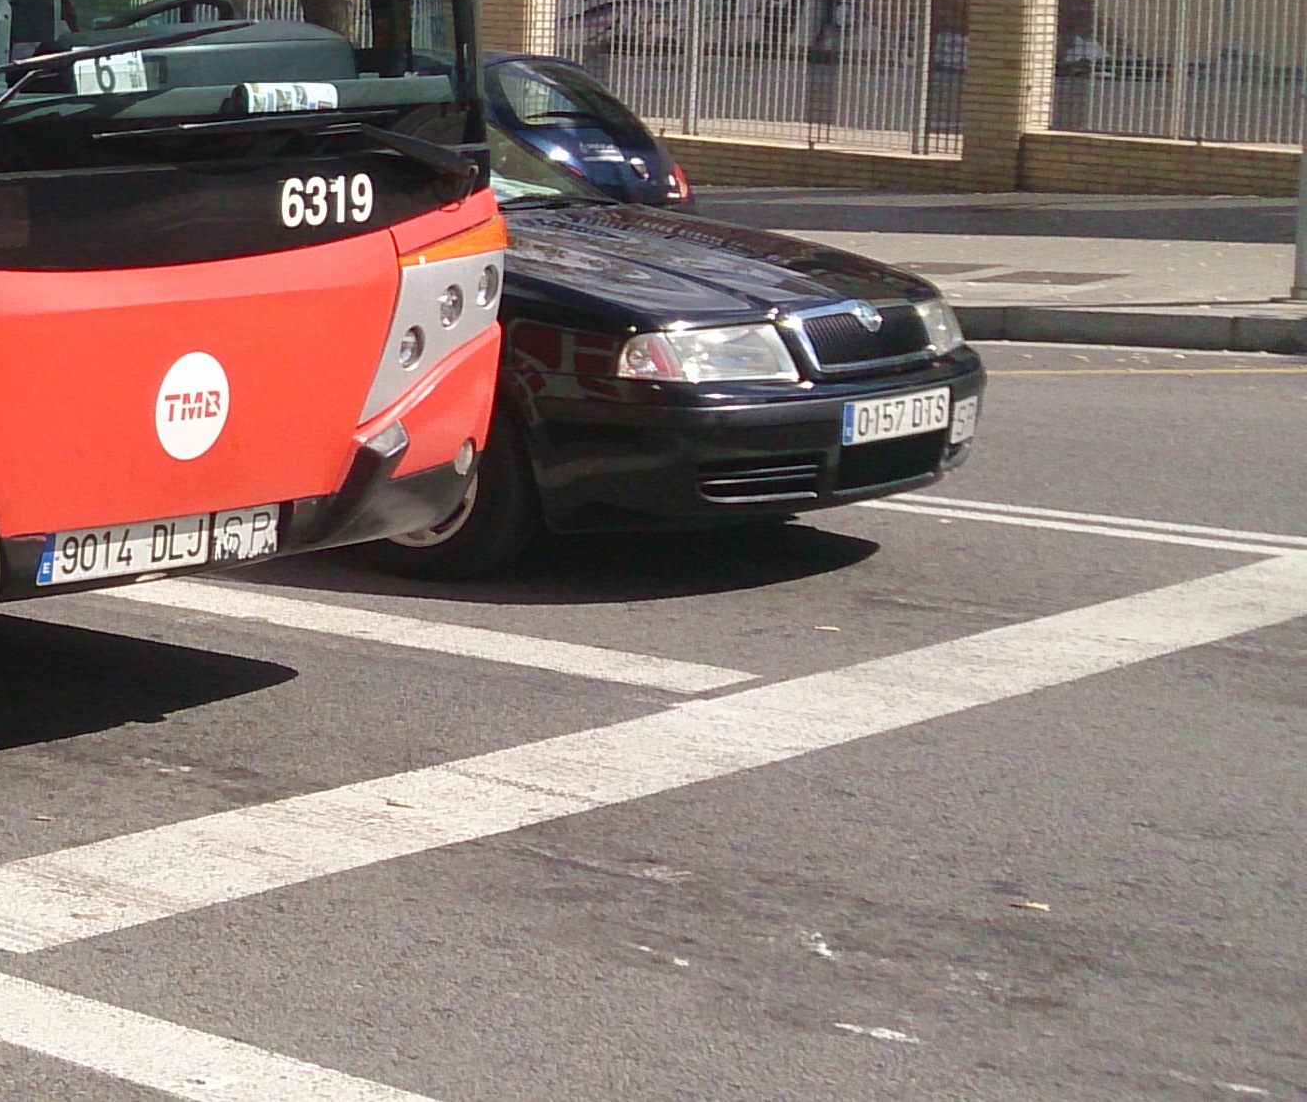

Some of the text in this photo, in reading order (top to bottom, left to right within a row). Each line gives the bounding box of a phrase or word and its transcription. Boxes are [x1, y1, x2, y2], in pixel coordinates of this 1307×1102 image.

[281, 173, 373, 227] 6319
[164, 390, 221, 423] TMB
[858, 394, 946, 436] 0157 DTS
[61, 518, 205, 574] 9014 DLJ
